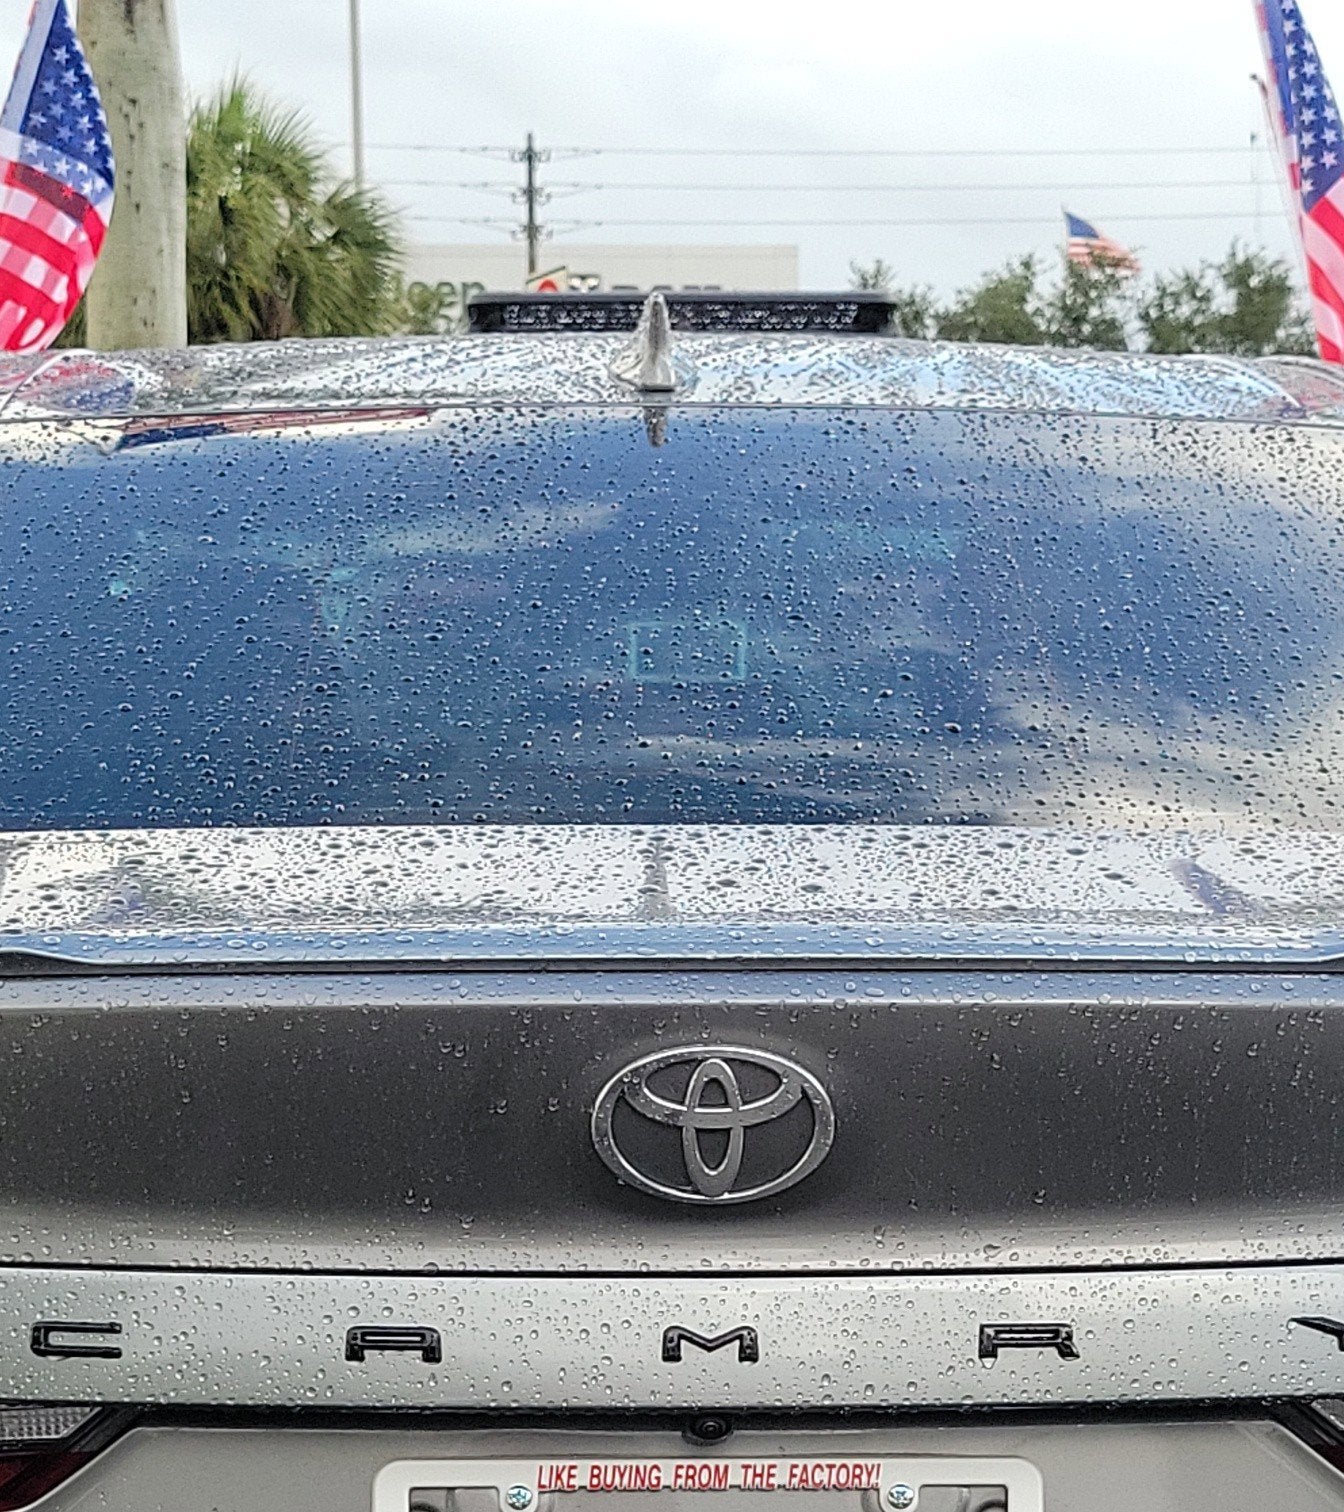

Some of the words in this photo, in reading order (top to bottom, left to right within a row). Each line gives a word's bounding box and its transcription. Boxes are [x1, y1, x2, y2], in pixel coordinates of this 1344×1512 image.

[537, 1465, 578, 1491] LIKE
[588, 1464, 662, 1491] BUYING
[673, 1464, 730, 1490] FROM
[741, 1464, 777, 1489] THE
[787, 1463, 881, 1489] FACTORY!
